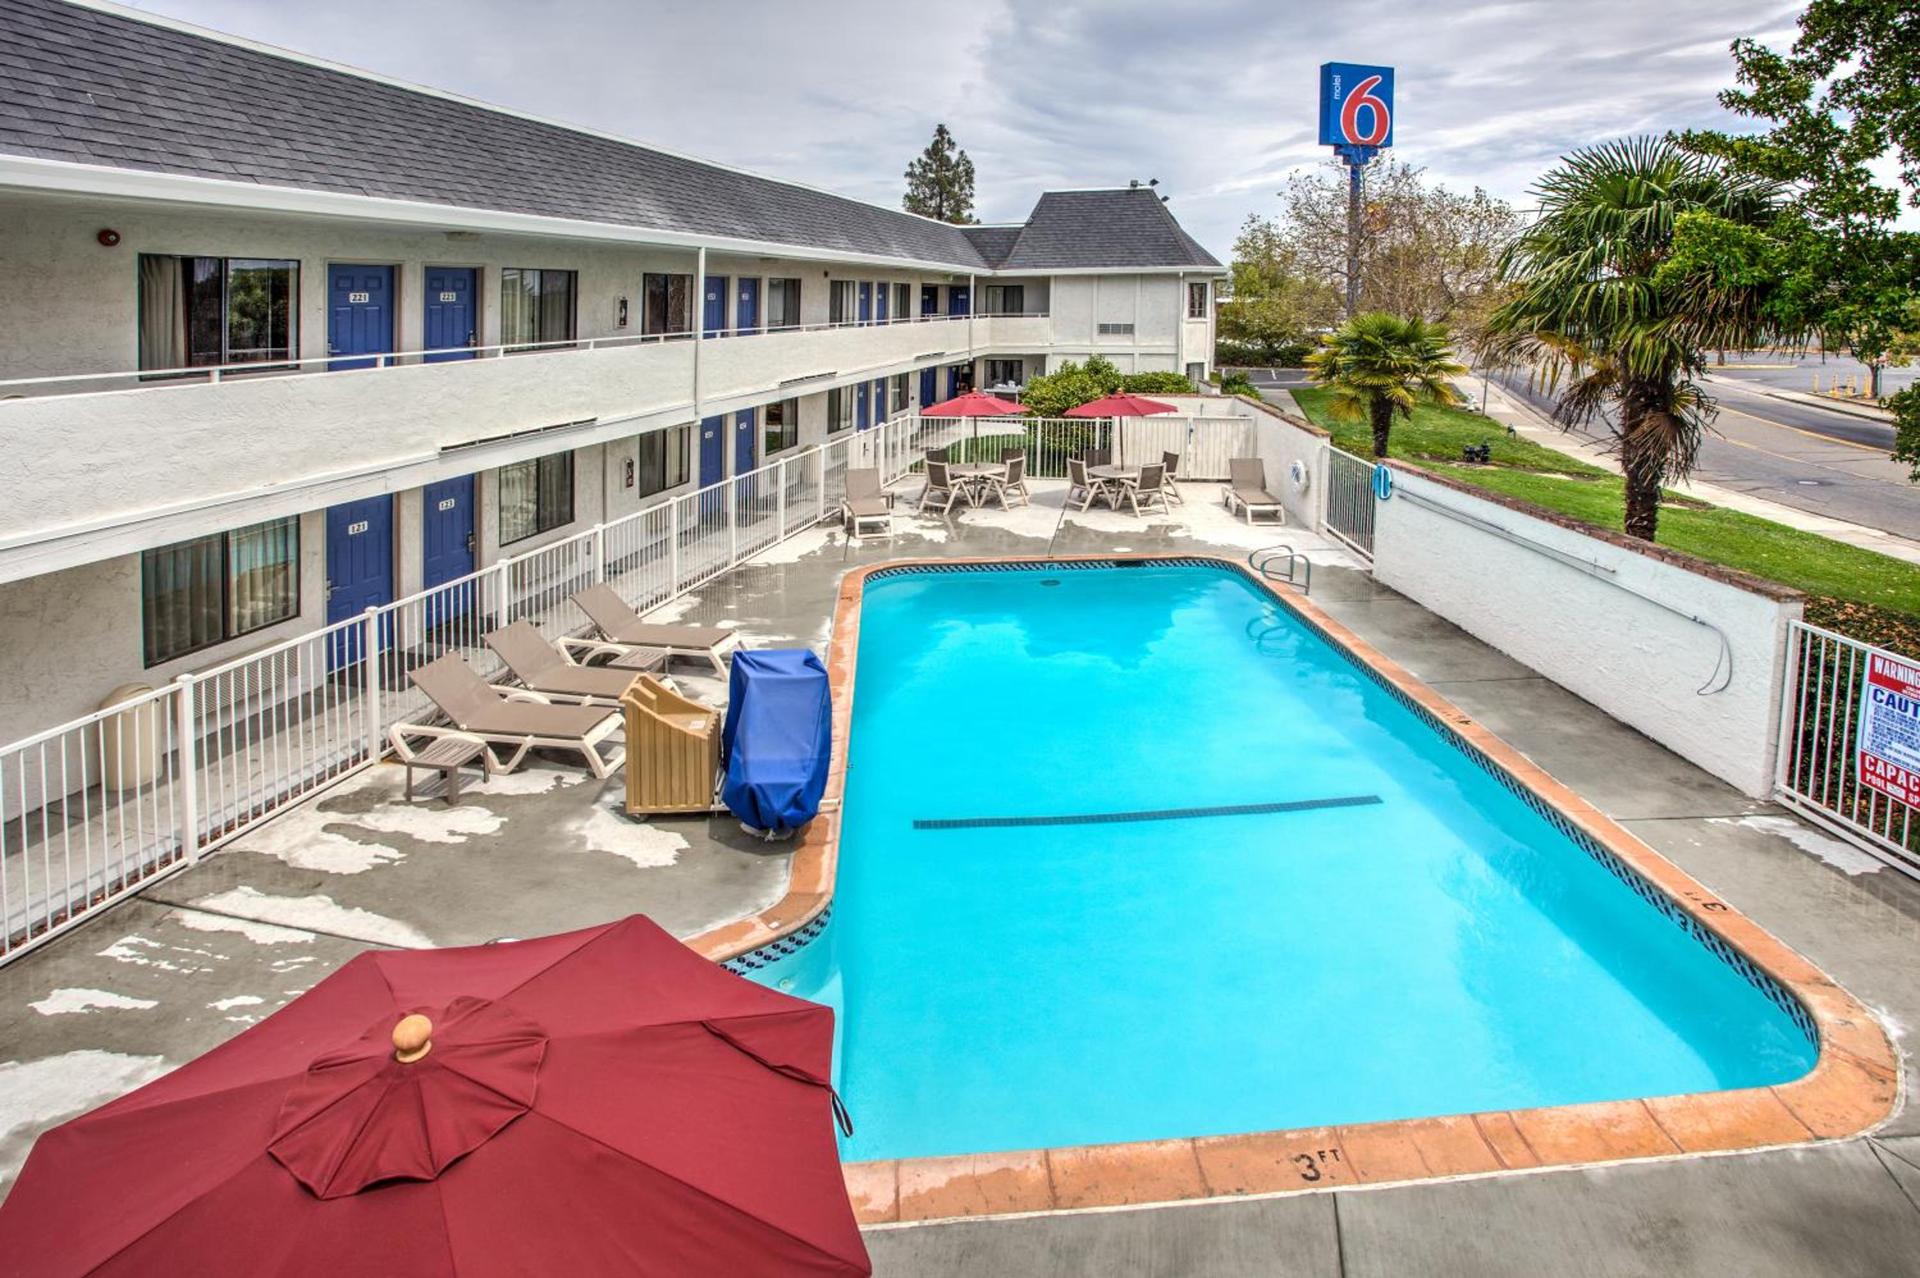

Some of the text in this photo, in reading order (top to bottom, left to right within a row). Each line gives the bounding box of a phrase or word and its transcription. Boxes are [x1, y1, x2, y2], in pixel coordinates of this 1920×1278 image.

[1332, 75, 1341, 99] motel
[1340, 75, 1391, 144] 6
[1865, 772, 1886, 791] POOL
[1294, 1148, 1340, 1182] 3 FT
